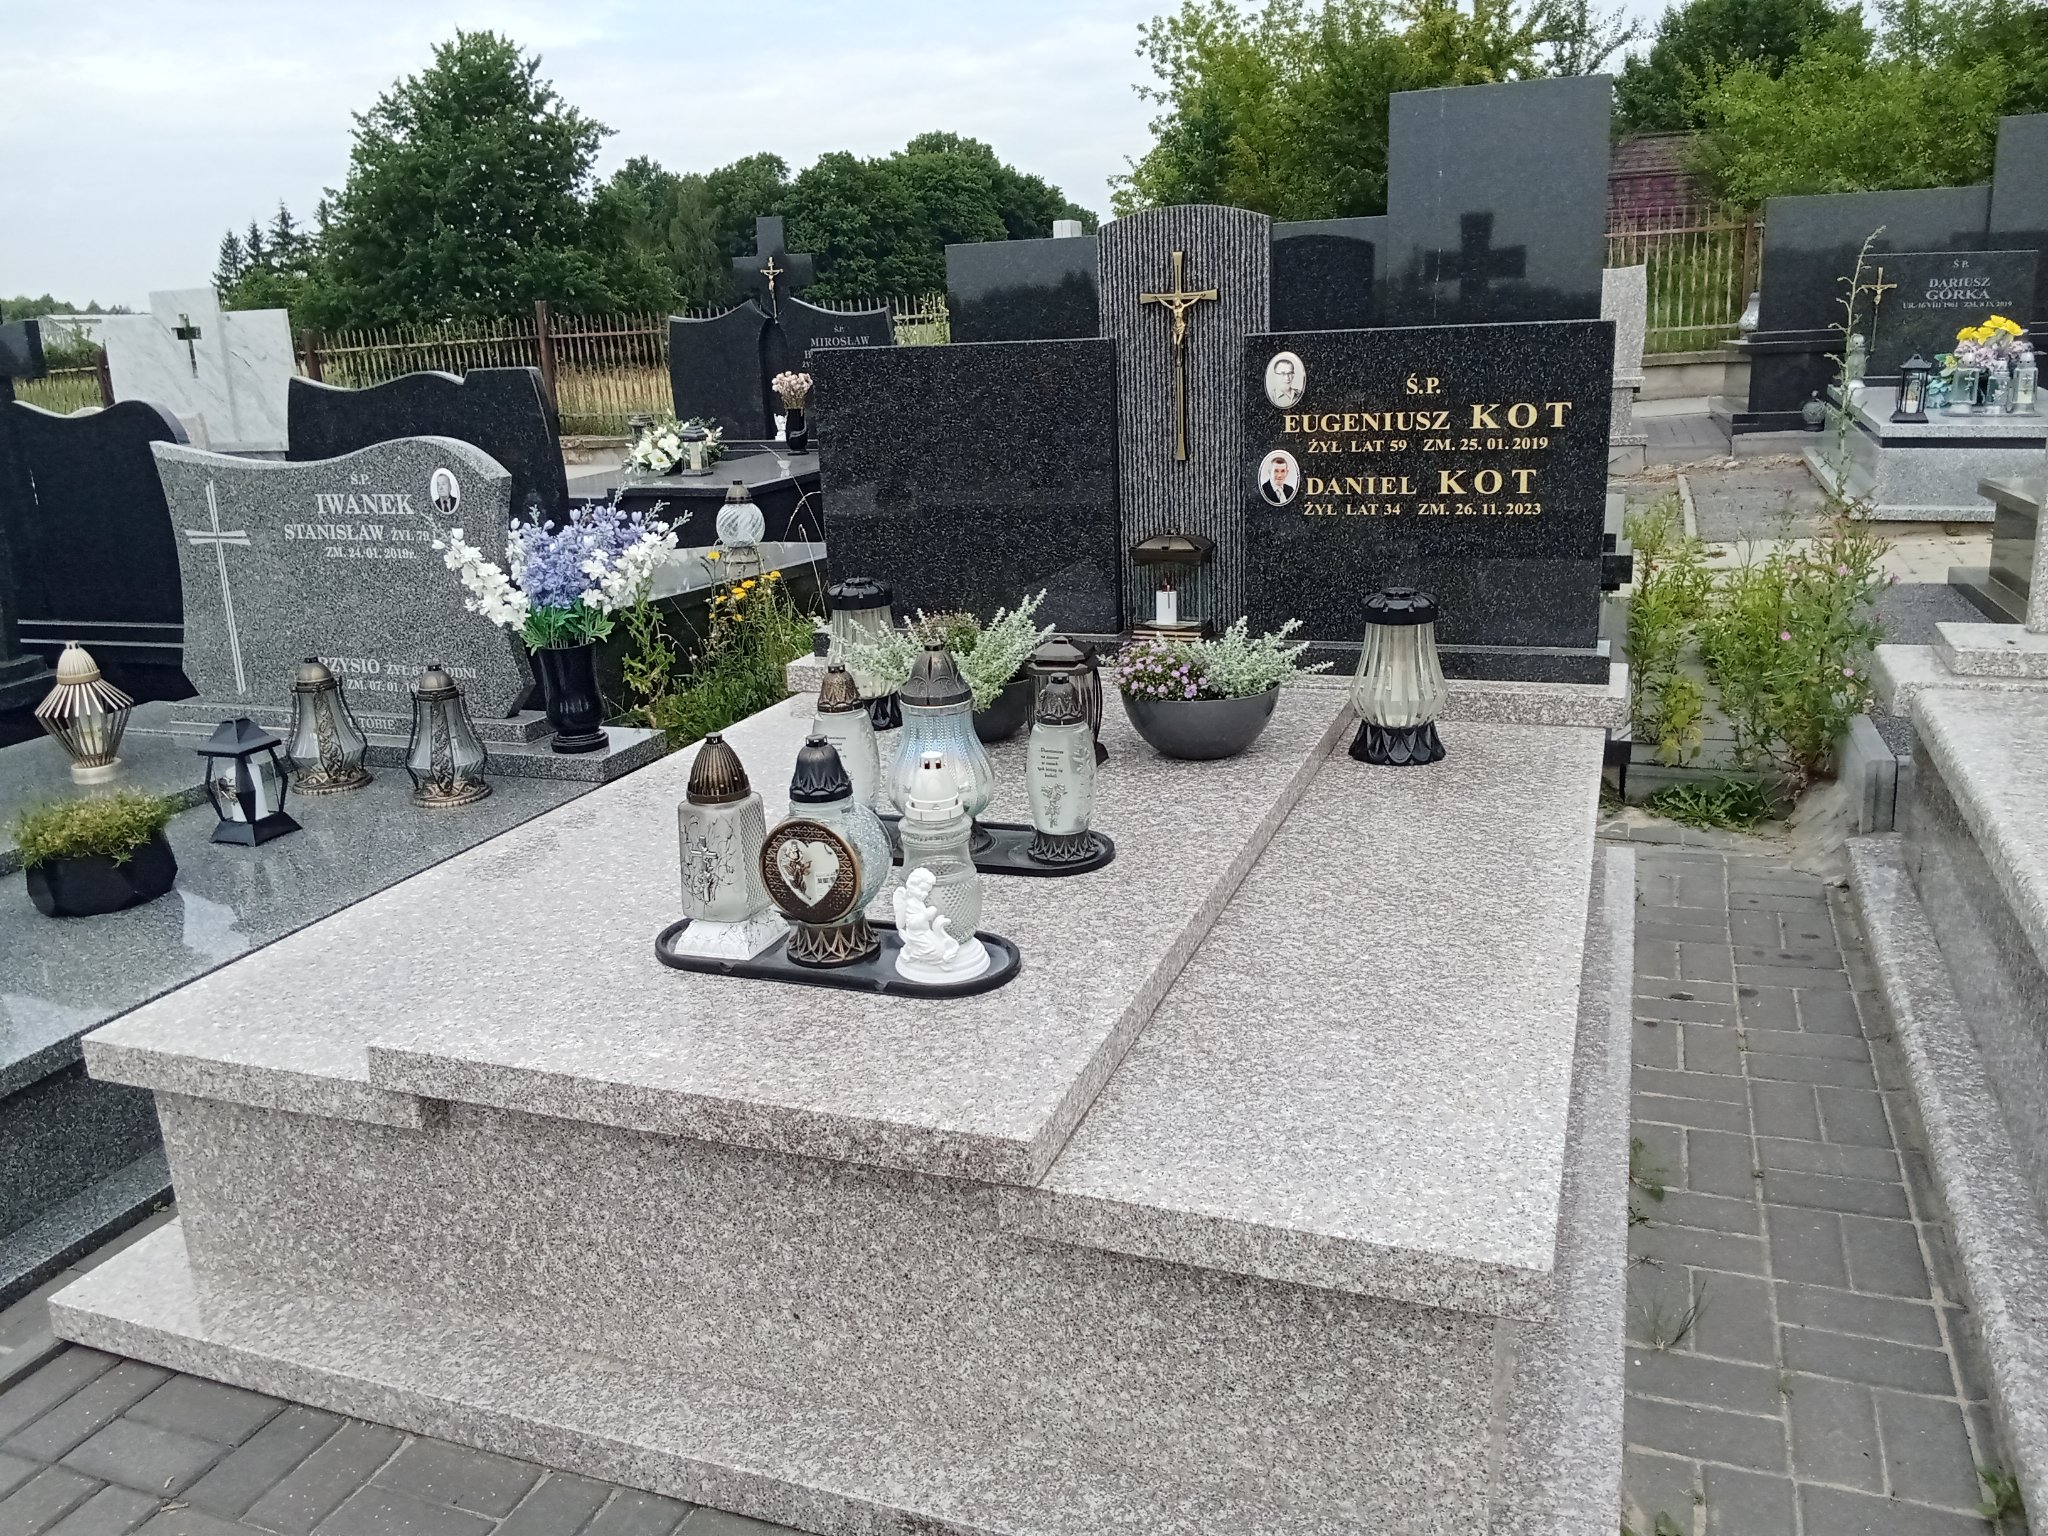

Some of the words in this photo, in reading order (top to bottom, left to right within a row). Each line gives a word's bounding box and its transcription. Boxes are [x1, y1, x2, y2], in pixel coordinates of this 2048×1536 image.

[1929, 277, 1991, 288] DARIUSZ
[1926, 286, 1991, 300] GÓRKA
[811, 336, 870, 347] MIROSŁAW
[1406, 373, 1441, 395] Ś.P.
[1283, 411, 1450, 434] EUGENIUSZ
[1470, 402, 1573, 430] KOT
[1308, 439, 1342, 454] ŻYŁ
[1351, 440, 1384, 453] LAT
[1389, 439, 1407, 453] 59
[1423, 438, 1456, 452] ZM.
[1306, 476, 1417, 496] DANIEL
[1438, 469, 1538, 495] KOT
[315, 493, 414, 515] IWANEK
[1304, 502, 1337, 516] ŻYŁ
[1346, 504, 1380, 516] LAT
[1383, 503, 1401, 516] 34
[1418, 503, 1450, 516] ZM.
[284, 524, 384, 541] STANISŁAW
[417, 531, 430, 541] 79
[326, 547, 347, 558] ZM.
[318, 657, 380, 674] RZYSIO
[346, 680, 368, 690] ZM.
[358, 718, 396, 730] TOBIE
